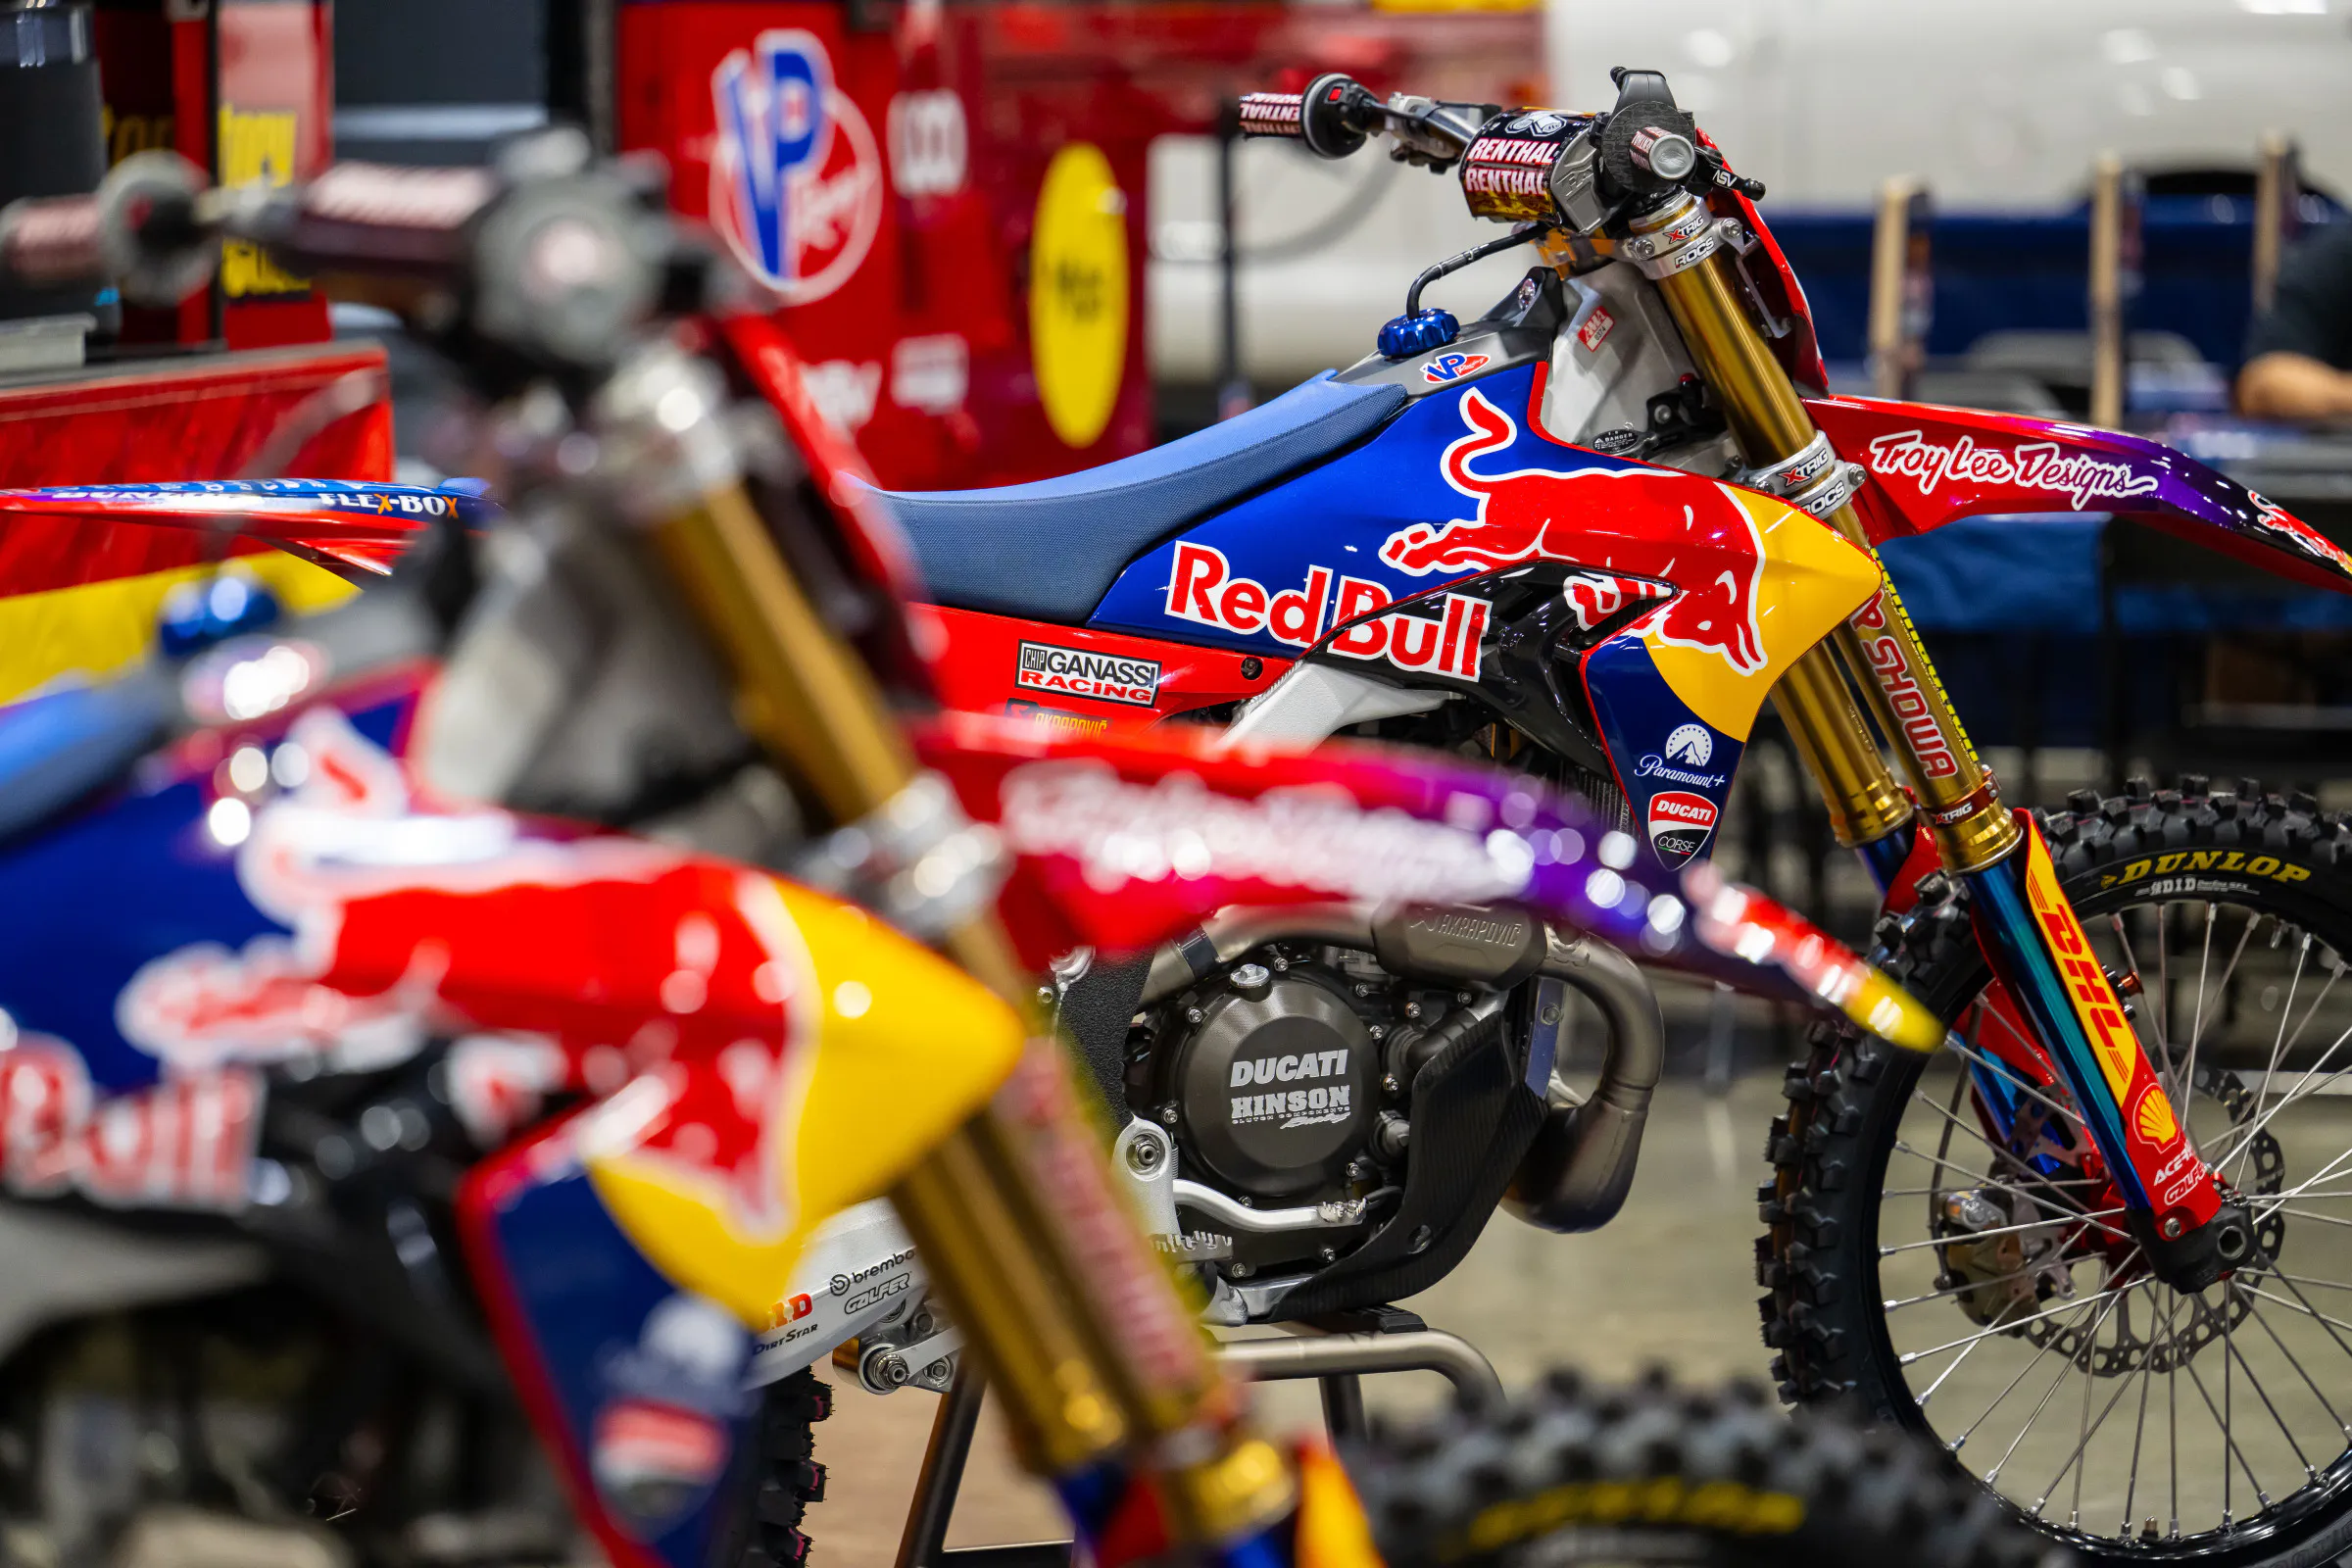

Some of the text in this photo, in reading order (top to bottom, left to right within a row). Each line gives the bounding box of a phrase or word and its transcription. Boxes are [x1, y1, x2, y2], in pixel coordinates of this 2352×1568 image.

[1239, 103, 1301, 122] ENTHAL
[1467, 137, 1560, 165] RENTHAL
[1465, 168, 1549, 196] RENTHAL
[1712, 169, 1739, 187] ASV
[1663, 215, 1704, 244] XTRIG
[1674, 236, 1715, 269] ROCS
[1425, 353, 1467, 381] VP
[1776, 448, 1830, 487] XTRIG
[1869, 429, 2159, 511] Troy Lee Designs
[318, 493, 460, 519] FLEX-BOX
[1164, 541, 1493, 683] Red Bull
[1024, 648, 1156, 688] CHIP GANASSI
[1020, 669, 1152, 703] RACING
[1861, 636, 1958, 780] SHOWA
[1634, 754, 1726, 788] Paramount+
[1656, 800, 1713, 821] DUCATI
[1933, 802, 1974, 825] XTRIG
[1658, 835, 1696, 854] CORSE
[2117, 850, 2312, 886] DUNLOP
[2040, 904, 2123, 1049] DHL
[1230, 1049, 1348, 1088] DUCATI
[1231, 1085, 1350, 1119] HINSON
[852, 1249, 915, 1284] brembo
[844, 1272, 910, 1315] GALFER
